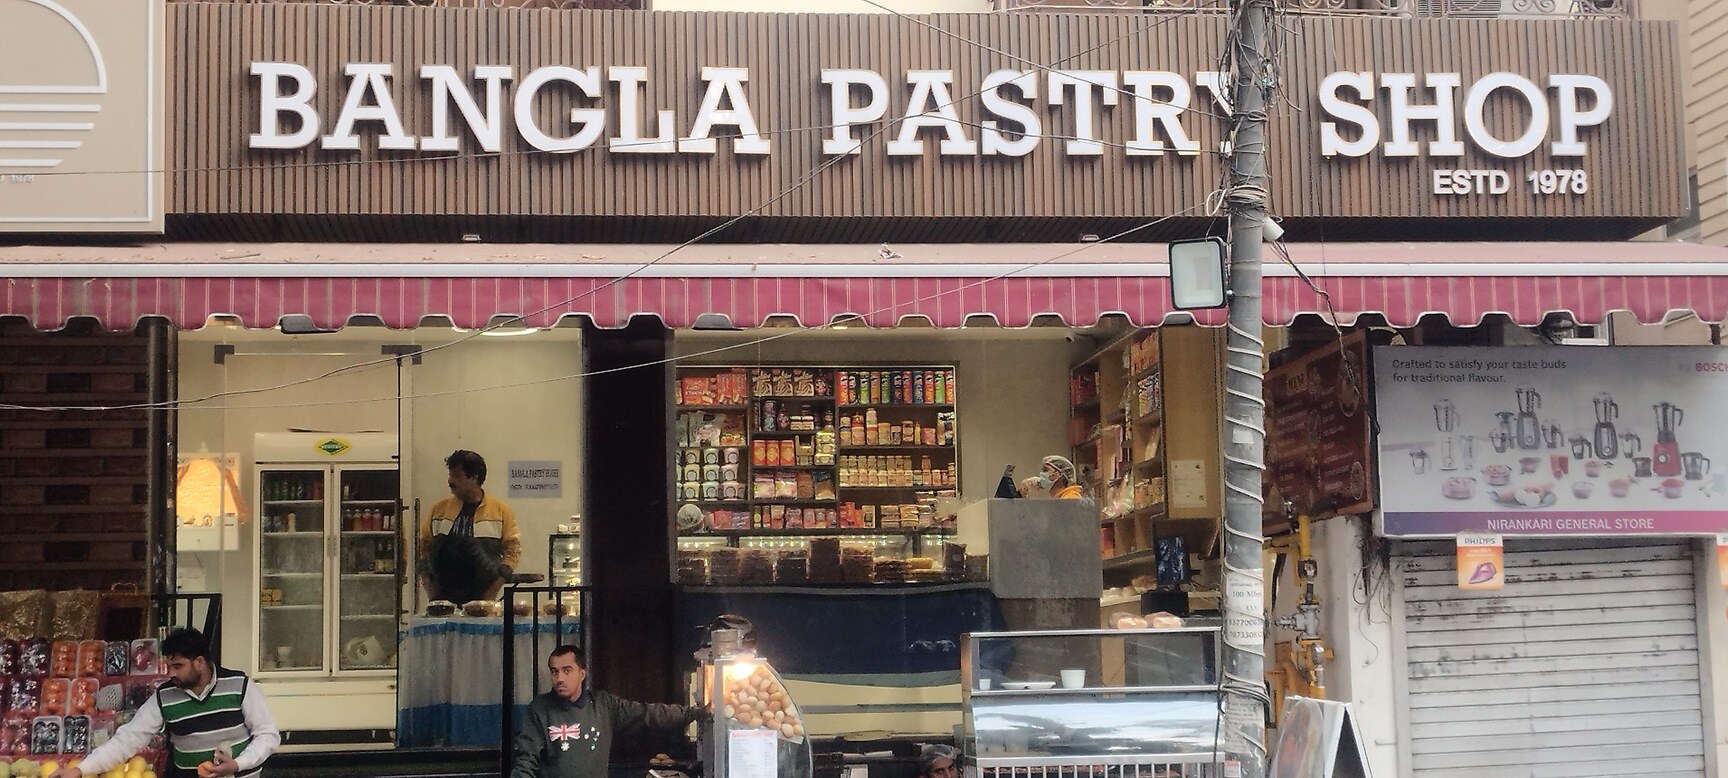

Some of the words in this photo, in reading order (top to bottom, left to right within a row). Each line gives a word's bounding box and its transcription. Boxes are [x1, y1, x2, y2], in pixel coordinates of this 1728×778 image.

[249, 62, 770, 154] BANGLA
[1319, 71, 1612, 157] SHOP
[1433, 170, 1510, 195] ESTD
[1526, 169, 1588, 194] 1978
[1392, 359, 1432, 369] Crafted
[1435, 360, 1446, 369] to
[1449, 359, 1483, 370] satisfy
[1486, 361, 1508, 370] your
[1512, 360, 1538, 369] taste
[1541, 359, 1567, 369] buds
[1393, 373, 1408, 382] for
[1411, 373, 1465, 382] traditional
[1468, 372, 1506, 383] flavour.
[1487, 519, 1552, 531] NIRANKARI
[1556, 518, 1612, 530] GENERAL
[1615, 518, 1654, 529] STORE
[1464, 537, 1496, 545] PHILIPS
